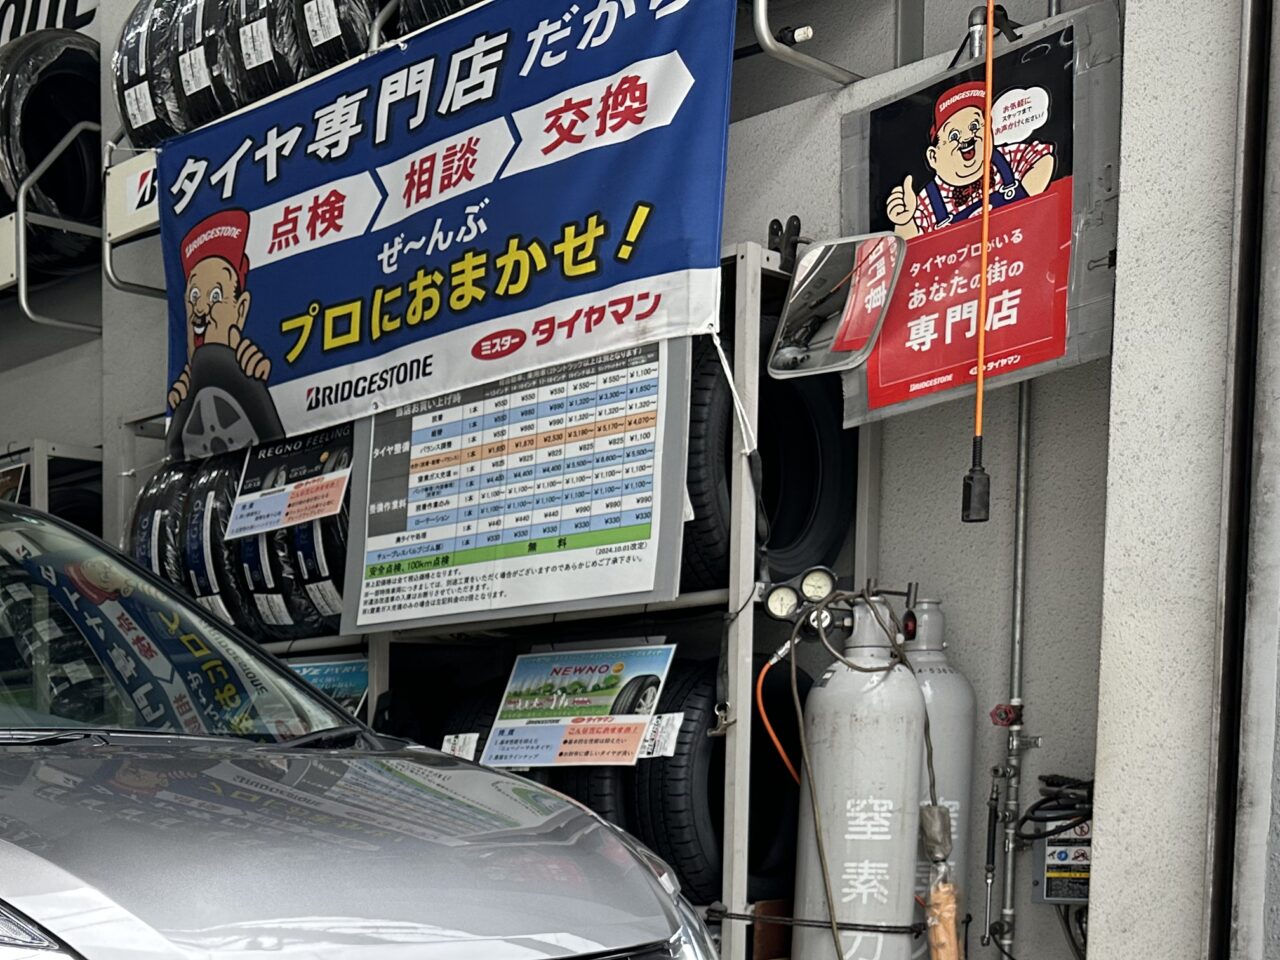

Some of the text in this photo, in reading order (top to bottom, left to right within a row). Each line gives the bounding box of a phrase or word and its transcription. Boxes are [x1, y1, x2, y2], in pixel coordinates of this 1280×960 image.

[540, 74, 648, 156] 交換
[1002, 96, 1032, 114] お気軽に
[402, 135, 481, 209] 相談
[184, 227, 242, 258] BRIDGESTONE
[267, 188, 347, 255] 点検
[907, 257, 1024, 310] あなたの街の
[531, 291, 662, 347] タイヤマン
[905, 288, 1022, 352] 専門店
[305, 354, 434, 411] BRIDGESTONE
[257, 425, 351, 460] REGNO FEELING
[373, 440, 410, 459] タイヤ整備
[550, 663, 610, 676] NEWNO
